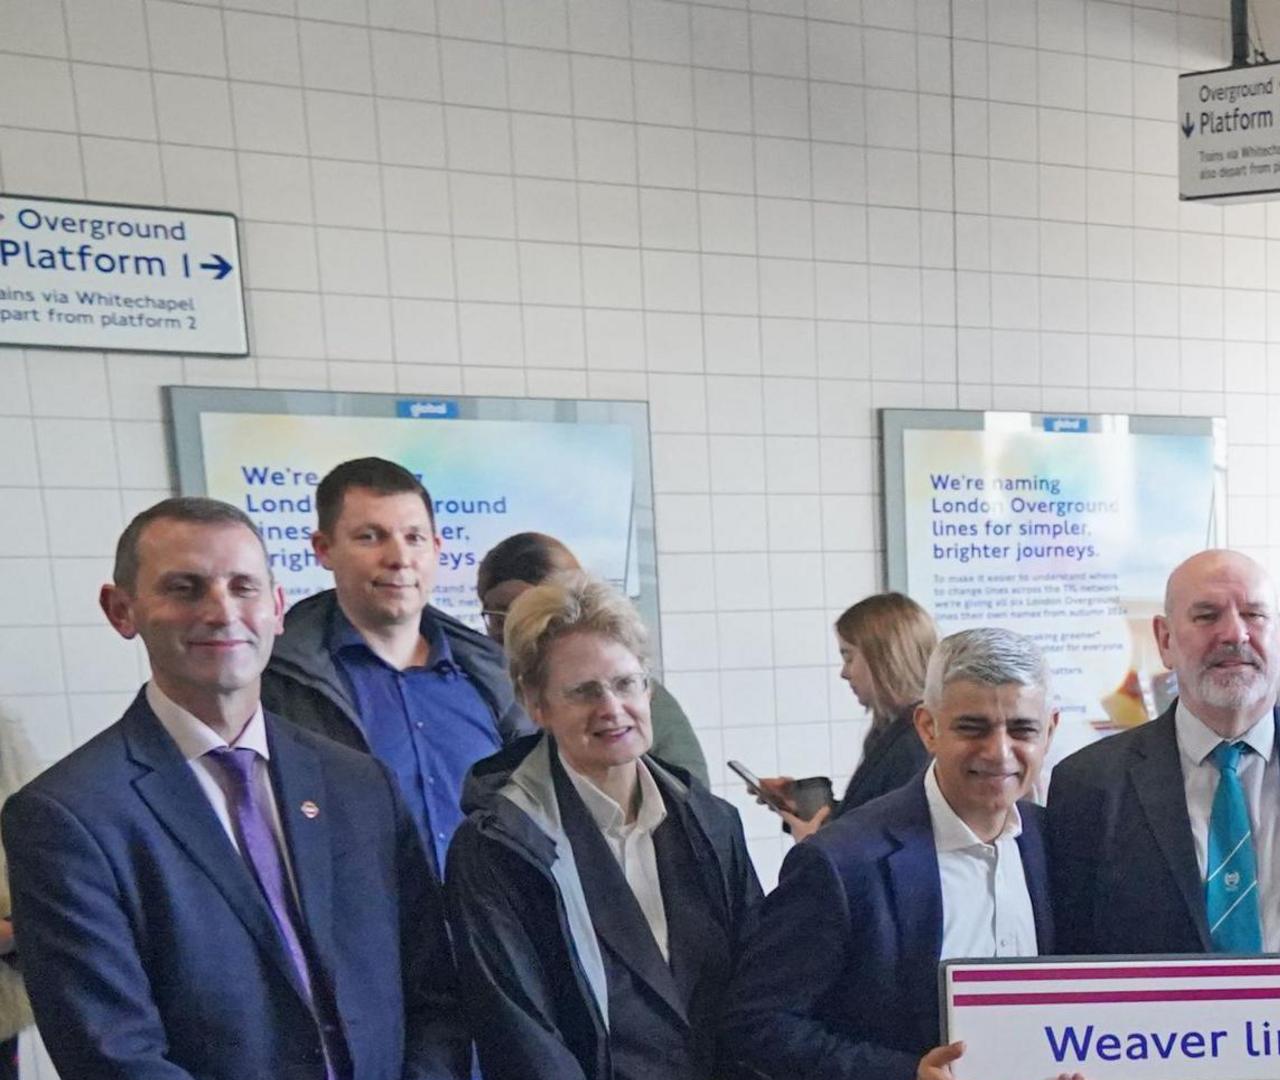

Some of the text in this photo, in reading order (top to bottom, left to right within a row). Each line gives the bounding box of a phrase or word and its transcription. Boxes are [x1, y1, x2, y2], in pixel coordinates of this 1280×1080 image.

[1199, 77, 1273, 103] Overground
[1200, 107, 1273, 135] Platform
[18, 208, 186, 241] Overground
[0, 238, 165, 276] Platform
[0, 290, 195, 312] ains via Whitechapel
[0, 309, 197, 330] part from platform 2
[241, 465, 318, 485] We're
[930, 474, 1061, 494] We're naming
[245, 494, 311, 514] Lond
[434, 496, 506, 514] round
[932, 497, 1119, 517] London Overground
[259, 521, 310, 540] ines
[932, 521, 978, 536] lines
[985, 520, 1012, 536] for
[933, 543, 1100, 563] brighter journeys.
[1045, 1025, 1228, 1062] Weaver
